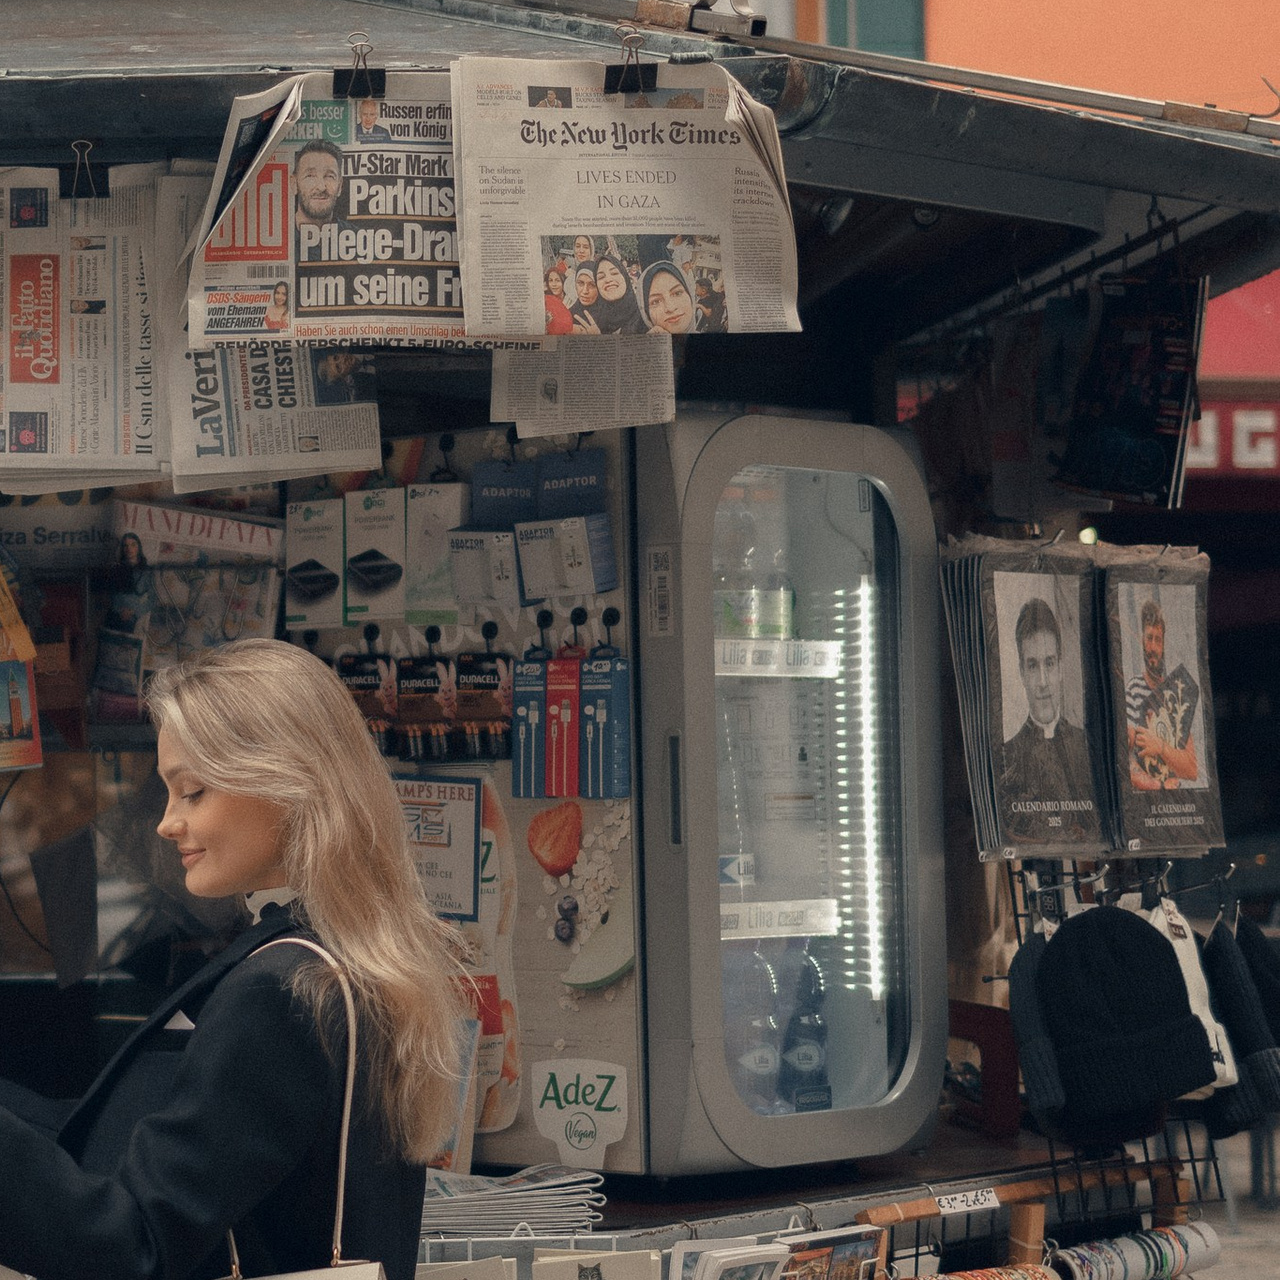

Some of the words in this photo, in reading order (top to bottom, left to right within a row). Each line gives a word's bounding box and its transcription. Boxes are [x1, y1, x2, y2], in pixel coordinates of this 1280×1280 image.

[310, 103, 345, 120] besser
[380, 102, 421, 120] Russen
[426, 102, 453, 120] erfin
[285, 123, 323, 139] RKEN
[390, 124, 411, 138] von
[413, 121, 447, 140] König
[520, 119, 558, 148] The
[560, 120, 607, 148] New
[611, 121, 665, 152] York
[668, 119, 742, 147] Times
[343, 153, 402, 177] TV-Star
[405, 154, 448, 178] Mark
[478, 165, 495, 175] The
[496, 165, 521, 175] silence
[734, 166, 760, 178] Russia
[478, 177, 490, 185] on
[491, 175, 516, 185] Sudan
[517, 176, 524, 185] is
[576, 169, 622, 185] LIVES
[625, 169, 677, 185] ENDED
[349, 179, 455, 217] Parkins
[479, 185, 526, 196] unforgivable
[597, 194, 614, 209] IN
[618, 194, 661, 209] GAZA
[732, 196, 775, 208] crackdown
[300, 275, 346, 307] um
[353, 268, 429, 306] seine
[437, 269, 464, 307] Fr
[135, 291, 149, 305] si
[207, 291, 271, 304] DSDS-Sängerin
[10, 280, 35, 333] Fatto
[207, 306, 226, 316] vom
[227, 304, 268, 316] Ehemann
[29, 259, 58, 380] Quotidiano
[206, 316, 266, 329] ANGEFAHREN
[136, 309, 152, 351] tasse
[296, 325, 323, 338] Haben
[324, 324, 337, 336] Sie
[338, 323, 358, 336] auch
[359, 323, 384, 336] schon
[385, 324, 409, 336] einen
[410, 324, 449, 339] Umschlag
[14, 345, 35, 358] il
[134, 354, 153, 397] delle
[239, 354, 251, 399] PRESIDENTE
[273, 347, 298, 409] CHIEST
[250, 362, 274, 410] CASA
[184, 348, 225, 458] LaVeri
[243, 400, 252, 411] DA
[134, 402, 153, 440] Csm
[135, 444, 153, 455] Il
[543, 475, 598, 490] ADAPTOR
[481, 486, 532, 499] ADAPTOR
[518, 527, 555, 537] ADAPTOR
[400, 678, 441, 689] DURACELL
[459, 674, 499, 685] DURACELL
[395, 781, 433, 799] AMP'S
[437, 784, 475, 801] HERE
[1011, 800, 1060, 813] CALENDARIO
[1060, 799, 1093, 812] ROMANO
[1158, 803, 1196, 814] CALENDARIO
[538, 1072, 618, 1112] AdeZ
[568, 1120, 596, 1142] Vegan
